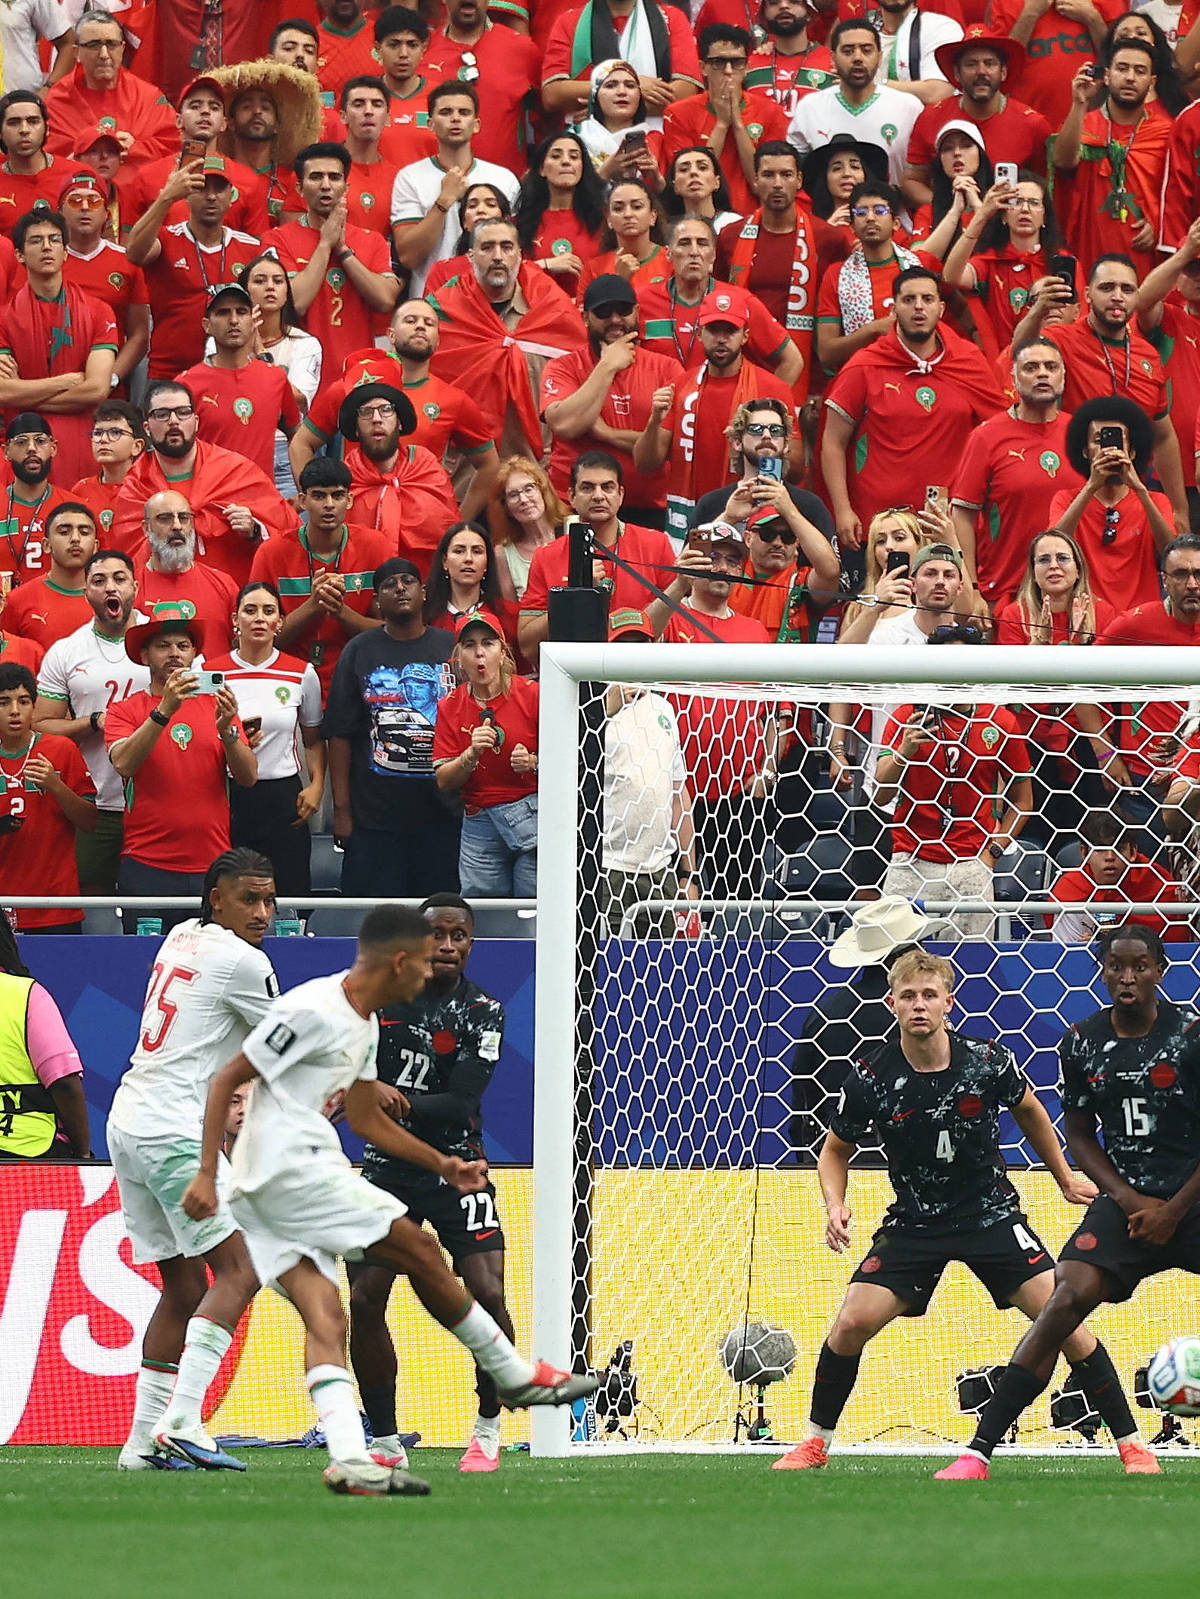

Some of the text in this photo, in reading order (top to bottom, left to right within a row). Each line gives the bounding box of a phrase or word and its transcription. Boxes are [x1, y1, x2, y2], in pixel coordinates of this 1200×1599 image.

[330, 297, 344, 326] 2
[26, 541, 43, 568] 2
[396, 1048, 430, 1091] 22
[1121, 1096, 1150, 1137] 15
[936, 1131, 955, 1163] 4
[461, 1193, 498, 1232] 22
[1012, 1224, 1039, 1251] 4
